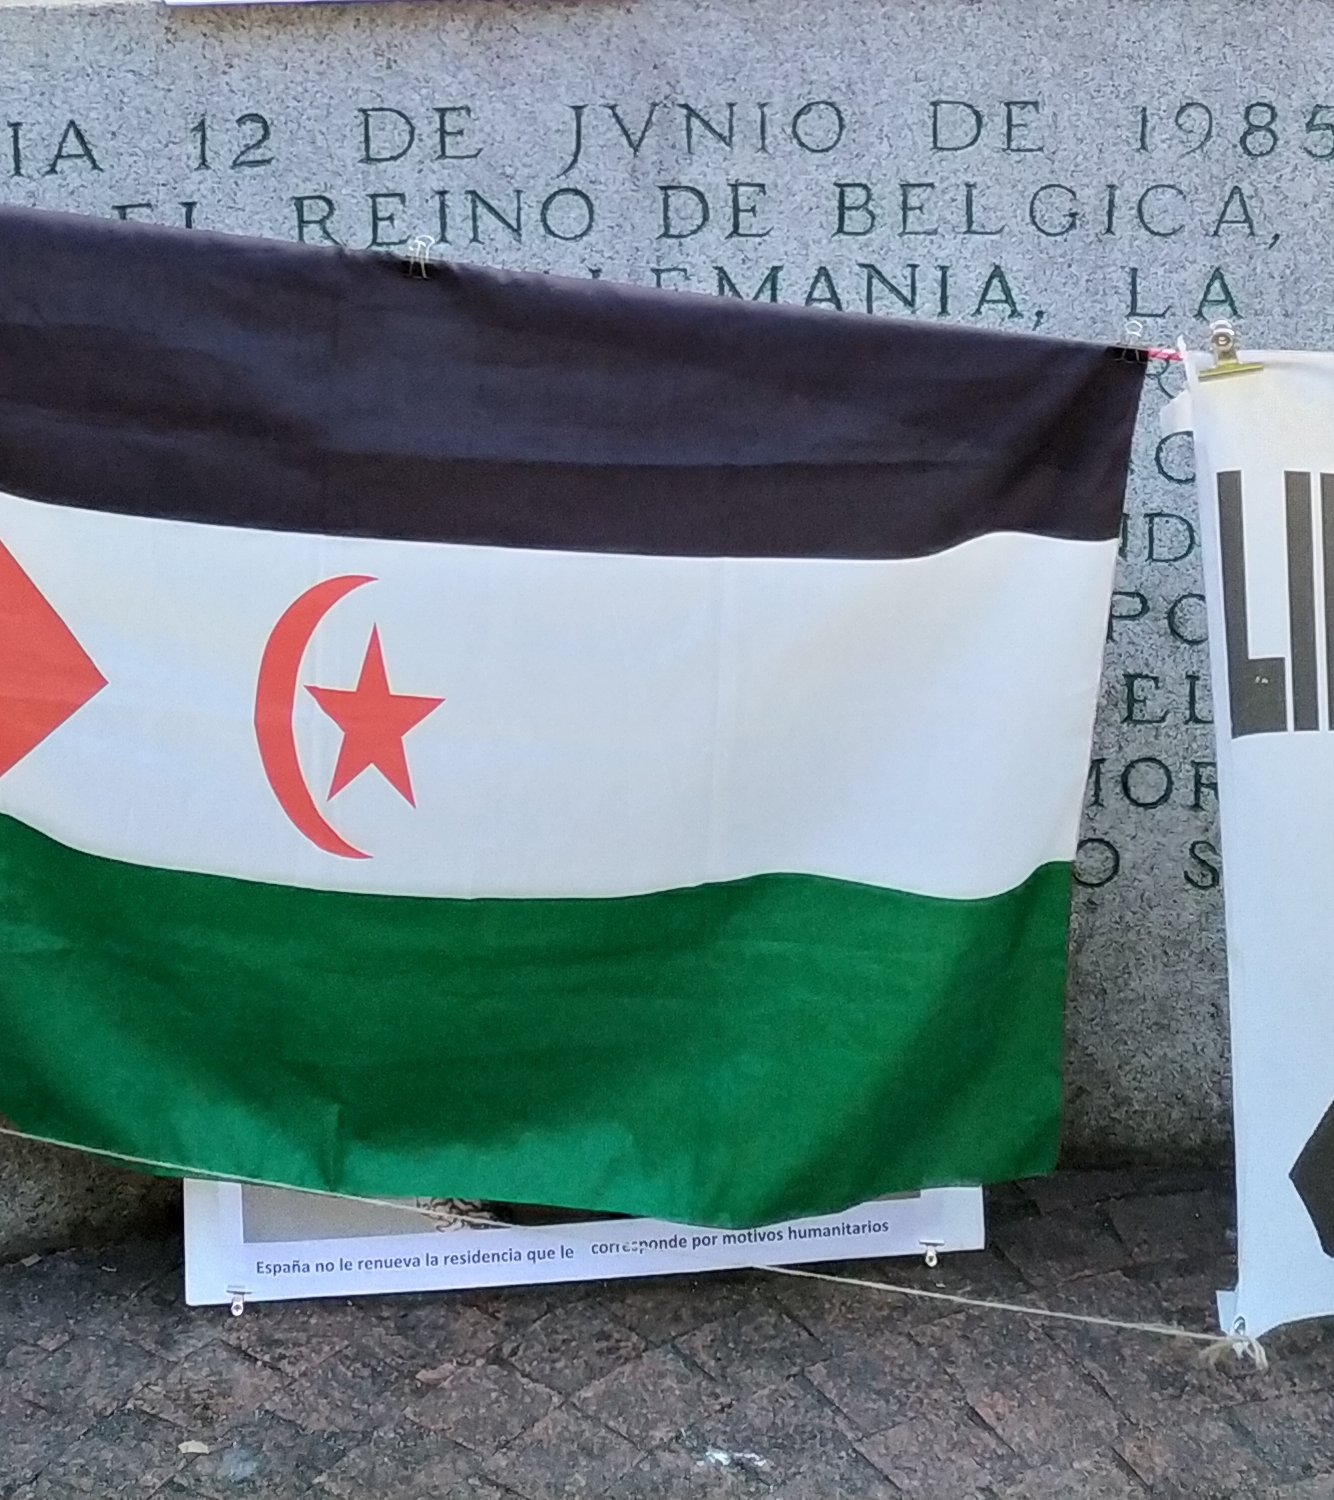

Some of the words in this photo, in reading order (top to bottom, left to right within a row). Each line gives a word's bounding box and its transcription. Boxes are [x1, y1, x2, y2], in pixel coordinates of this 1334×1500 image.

[189, 111, 276, 172] 12
[357, 104, 484, 164] DE
[556, 99, 847, 180] JVNIO
[929, 99, 1045, 153] DE
[290, 186, 595, 249] REINO
[656, 181, 774, 241] DE
[831, 181, 1281, 250] BELGICA,
[1124, 266, 1246, 321] LA
[255, 1258, 311, 1276] España
[315, 1261, 335, 1273] no
[339, 1256, 353, 1271] le
[357, 1254, 421, 1270] renueva
[425, 1252, 439, 1267] la
[443, 1246, 523, 1266] residencia
[526, 1248, 556, 1265] que
[560, 1245, 575, 1259] le
[691, 1235, 718, 1251] por
[722, 1227, 784, 1246] motivos
[787, 1220, 890, 1241] humanitarios
